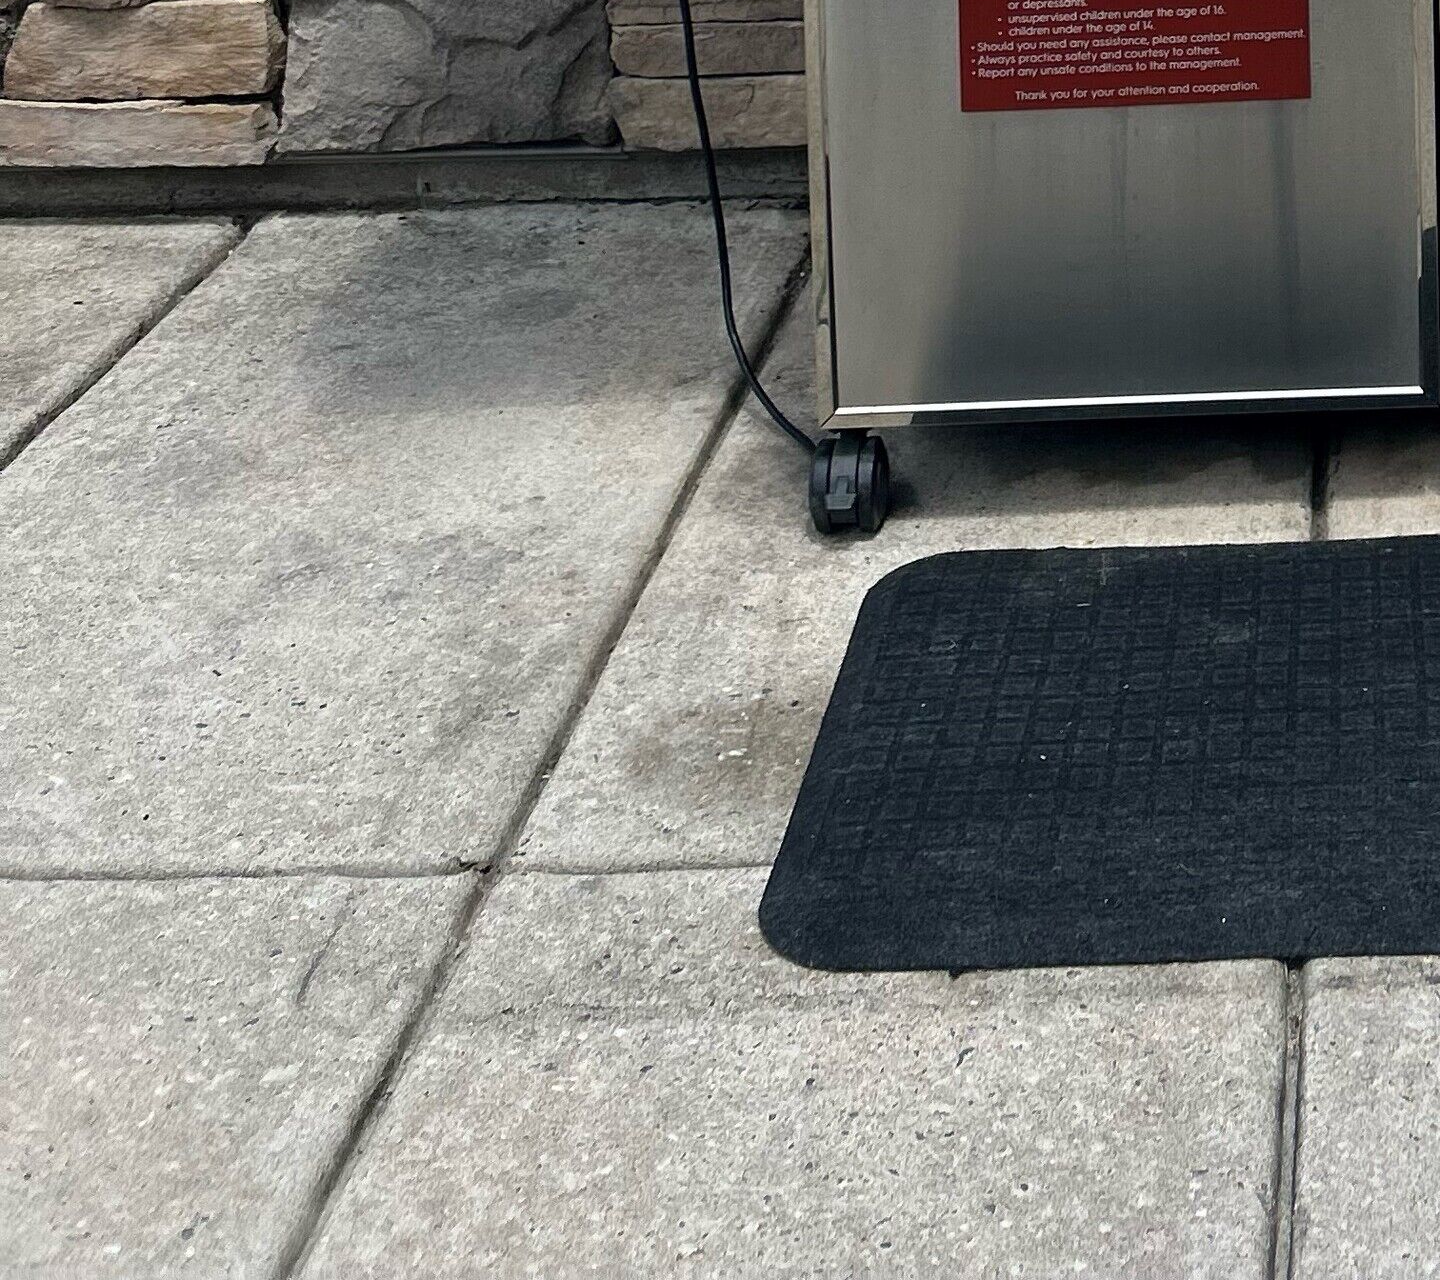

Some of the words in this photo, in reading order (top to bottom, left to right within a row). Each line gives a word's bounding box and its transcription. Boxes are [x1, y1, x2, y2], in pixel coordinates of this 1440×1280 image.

[1007, 2, 1019, 10] or
[1008, 12, 1077, 24] unsupervised
[1080, 10, 1121, 20] children
[1124, 9, 1153, 19] under
[1157, 8, 1173, 17] the
[1176, 7, 1197, 18] age
[1200, 5, 1211, 15] of
[1214, 5, 1226, 15] 16.
[1008, 26, 1050, 36] children
[1052, 25, 1082, 34] under
[1086, 23, 1103, 33] the
[1105, 24, 1126, 34] age
[1129, 21, 1140, 31] of
[977, 41, 1014, 52] Should
[1017, 42, 1036, 53] you
[1039, 39, 1067, 49] need
[1069, 39, 1089, 50] any
[1152, 34, 1188, 46] please
[1190, 32, 1230, 42] contact
[1233, 28, 1305, 41] management.
[977, 54, 1016, 65] Always
[1018, 52, 1062, 64] practice
[1065, 51, 1098, 61] safety
[1100, 50, 1121, 59] and
[1124, 48, 1170, 59] courtesy
[1172, 48, 1183, 56] to
[1187, 46, 1222, 56] others.
[978, 68, 1014, 79] Report
[1017, 67, 1038, 77] any
[1040, 65, 1076, 76] unsafe
[1078, 62, 1133, 73] conditions
[1135, 62, 1147, 71] to
[1150, 61, 1166, 70] the
[1169, 57, 1242, 71] management.
[1016, 90, 1048, 100] Thank
[1050, 91, 1070, 101] you
[1073, 88, 1087, 98] for
[1091, 89, 1115, 100] your
[1118, 85, 1166, 96] attention
[1168, 84, 1189, 94] and
[1192, 81, 1260, 93] cooperation.
